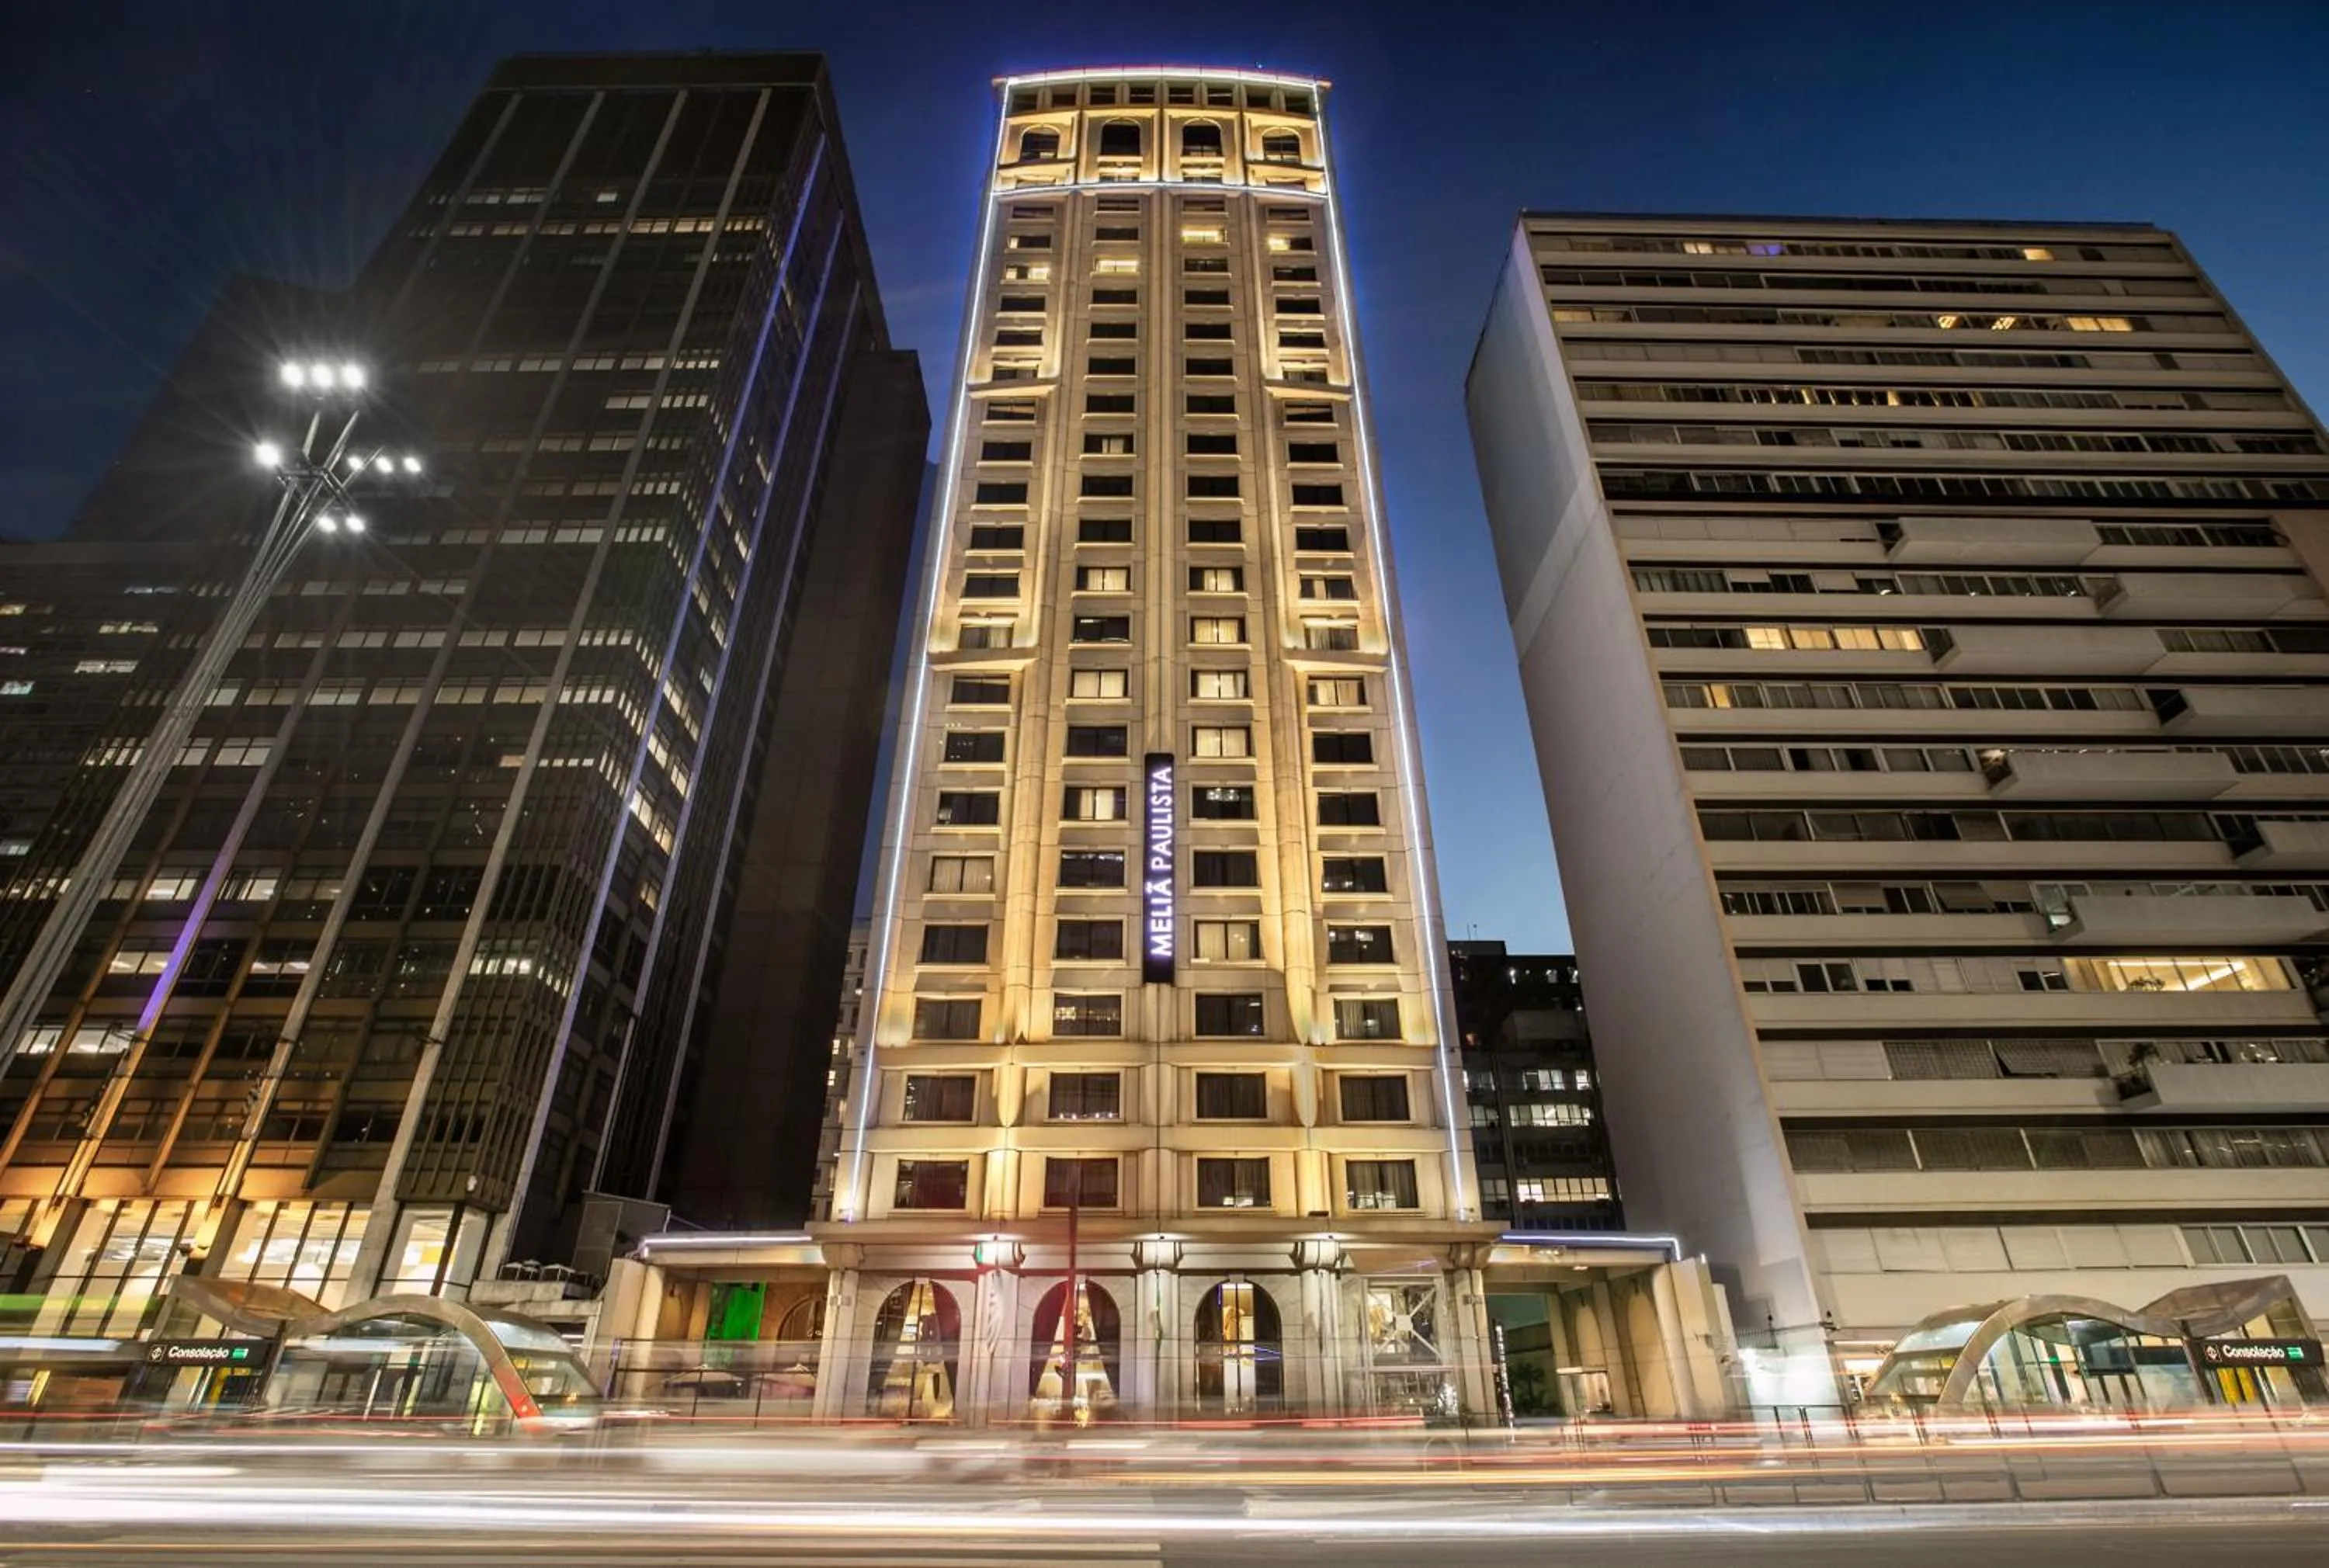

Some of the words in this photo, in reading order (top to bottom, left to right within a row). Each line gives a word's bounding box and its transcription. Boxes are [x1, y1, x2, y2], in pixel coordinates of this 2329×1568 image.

[1151, 766, 1172, 870] PAULISTA
[168, 1345, 229, 1359] Consolação
[2223, 1344, 2285, 1359] Consolação
